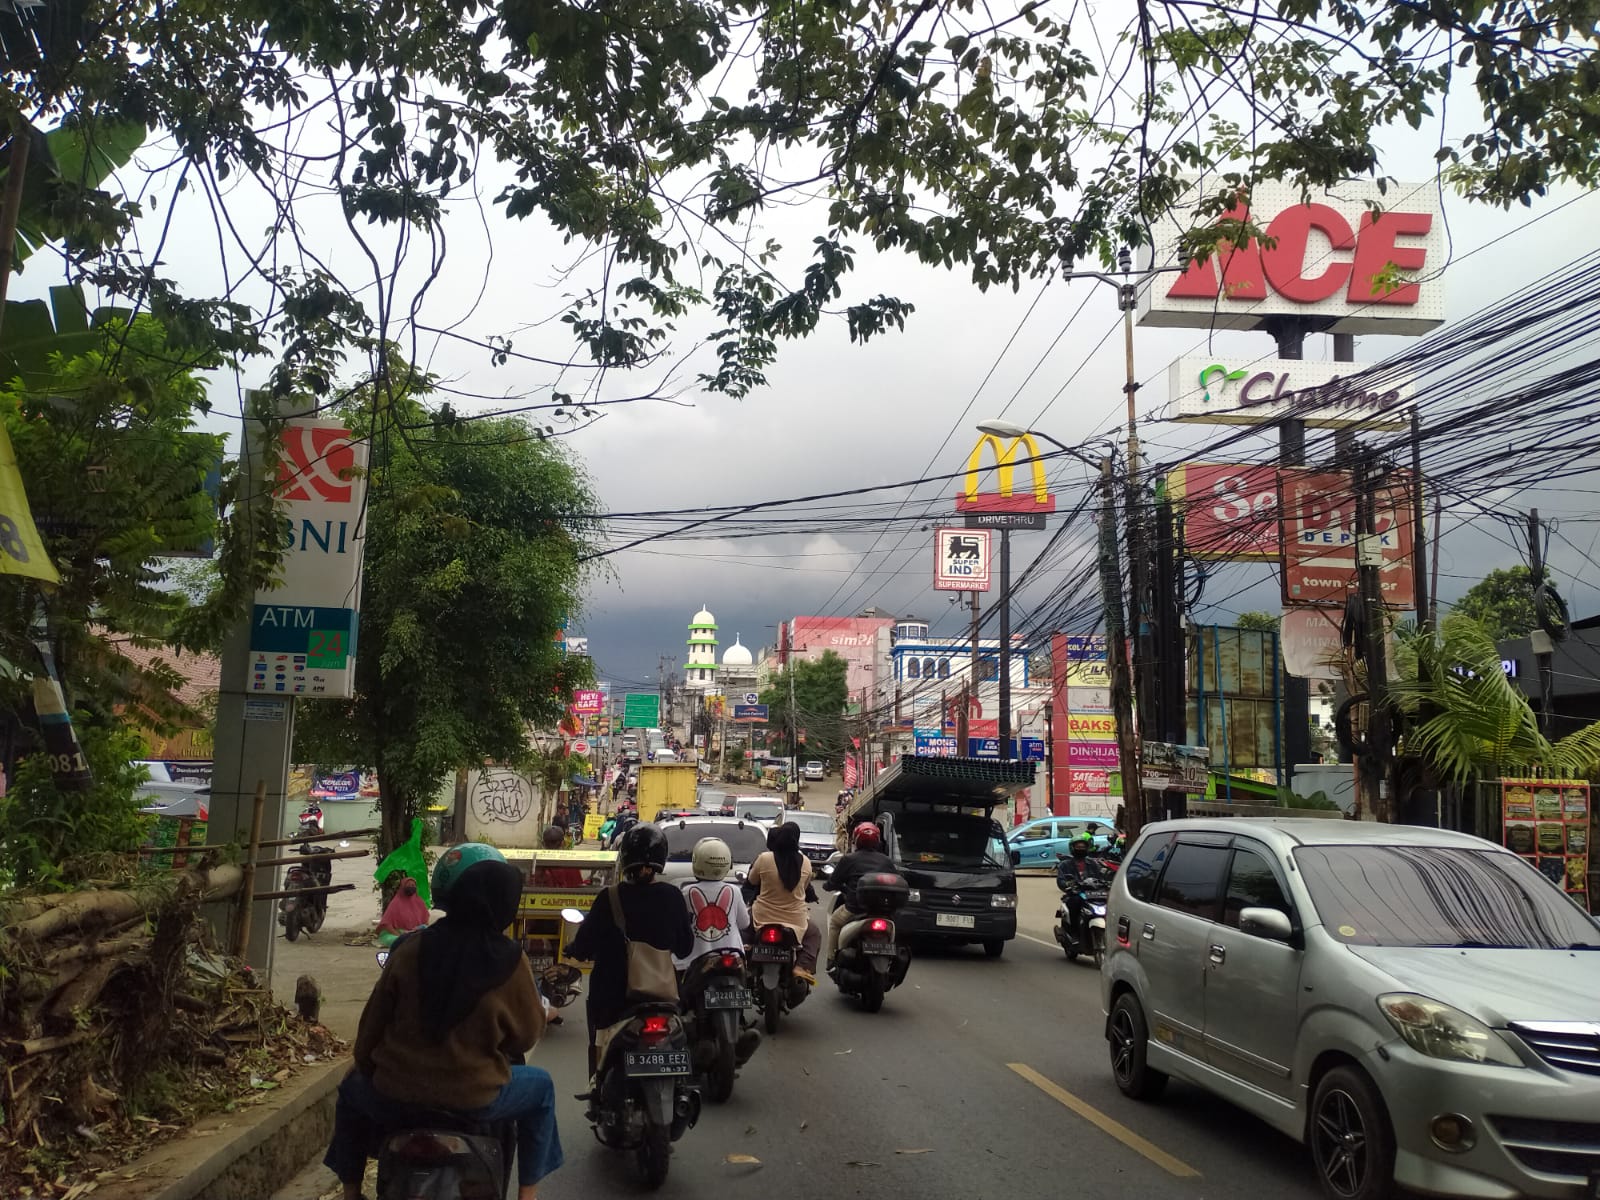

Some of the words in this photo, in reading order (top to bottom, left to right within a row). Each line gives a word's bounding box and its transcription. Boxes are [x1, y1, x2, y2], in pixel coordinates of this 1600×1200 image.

[1165, 186, 1433, 306] ACE
[977, 514, 1035, 525] DRIVETHRU
[281, 518, 348, 553] BNI
[1304, 530, 1391, 546] DEPK
[938, 581, 989, 591] SUPERMARKET
[1302, 576, 1342, 588] town
[1346, 580, 1398, 591] cer
[260, 607, 315, 629] ATM
[309, 631, 342, 657] 24
[1070, 719, 1113, 731] BAKS
[918, 746, 957, 754] CHANE
[629, 1055, 634, 1064] B
[669, 1054, 686, 1064] EEZ
